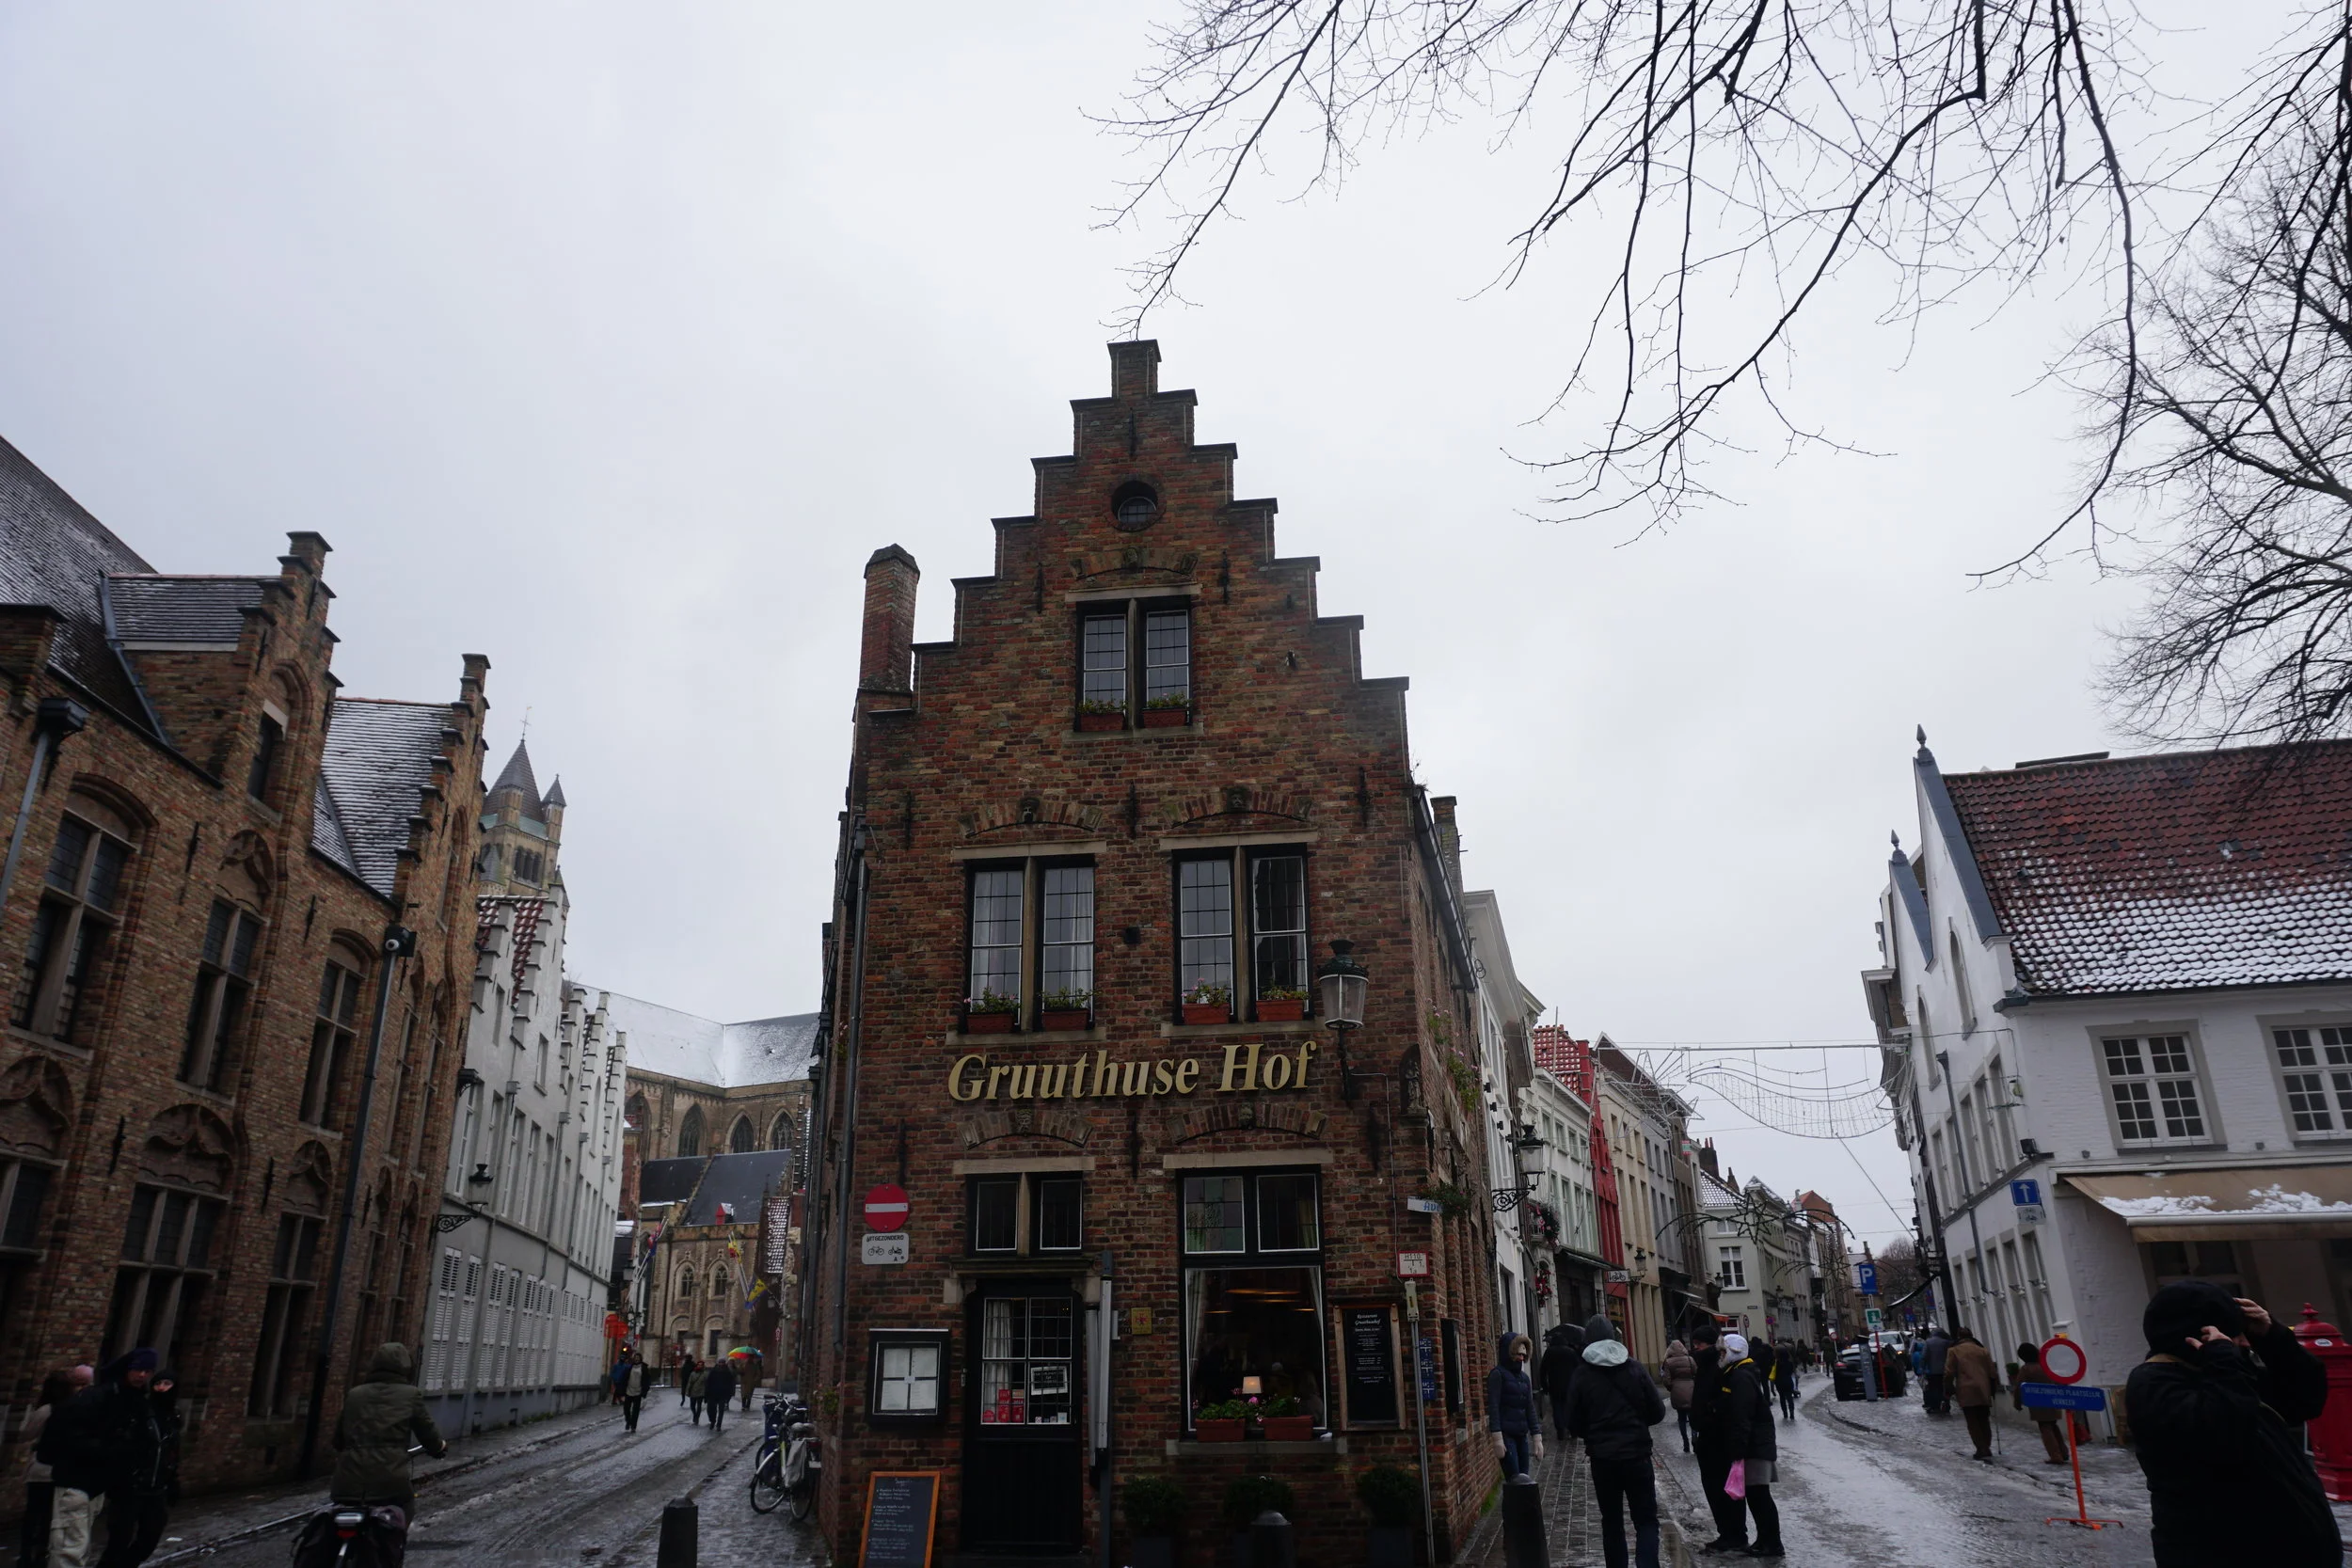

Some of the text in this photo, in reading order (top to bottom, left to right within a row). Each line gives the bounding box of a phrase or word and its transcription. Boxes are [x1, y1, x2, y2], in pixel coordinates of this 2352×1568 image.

[948, 1040, 1317, 1101] Gruuthuse Hof
[1861, 1267, 1873, 1284] P
